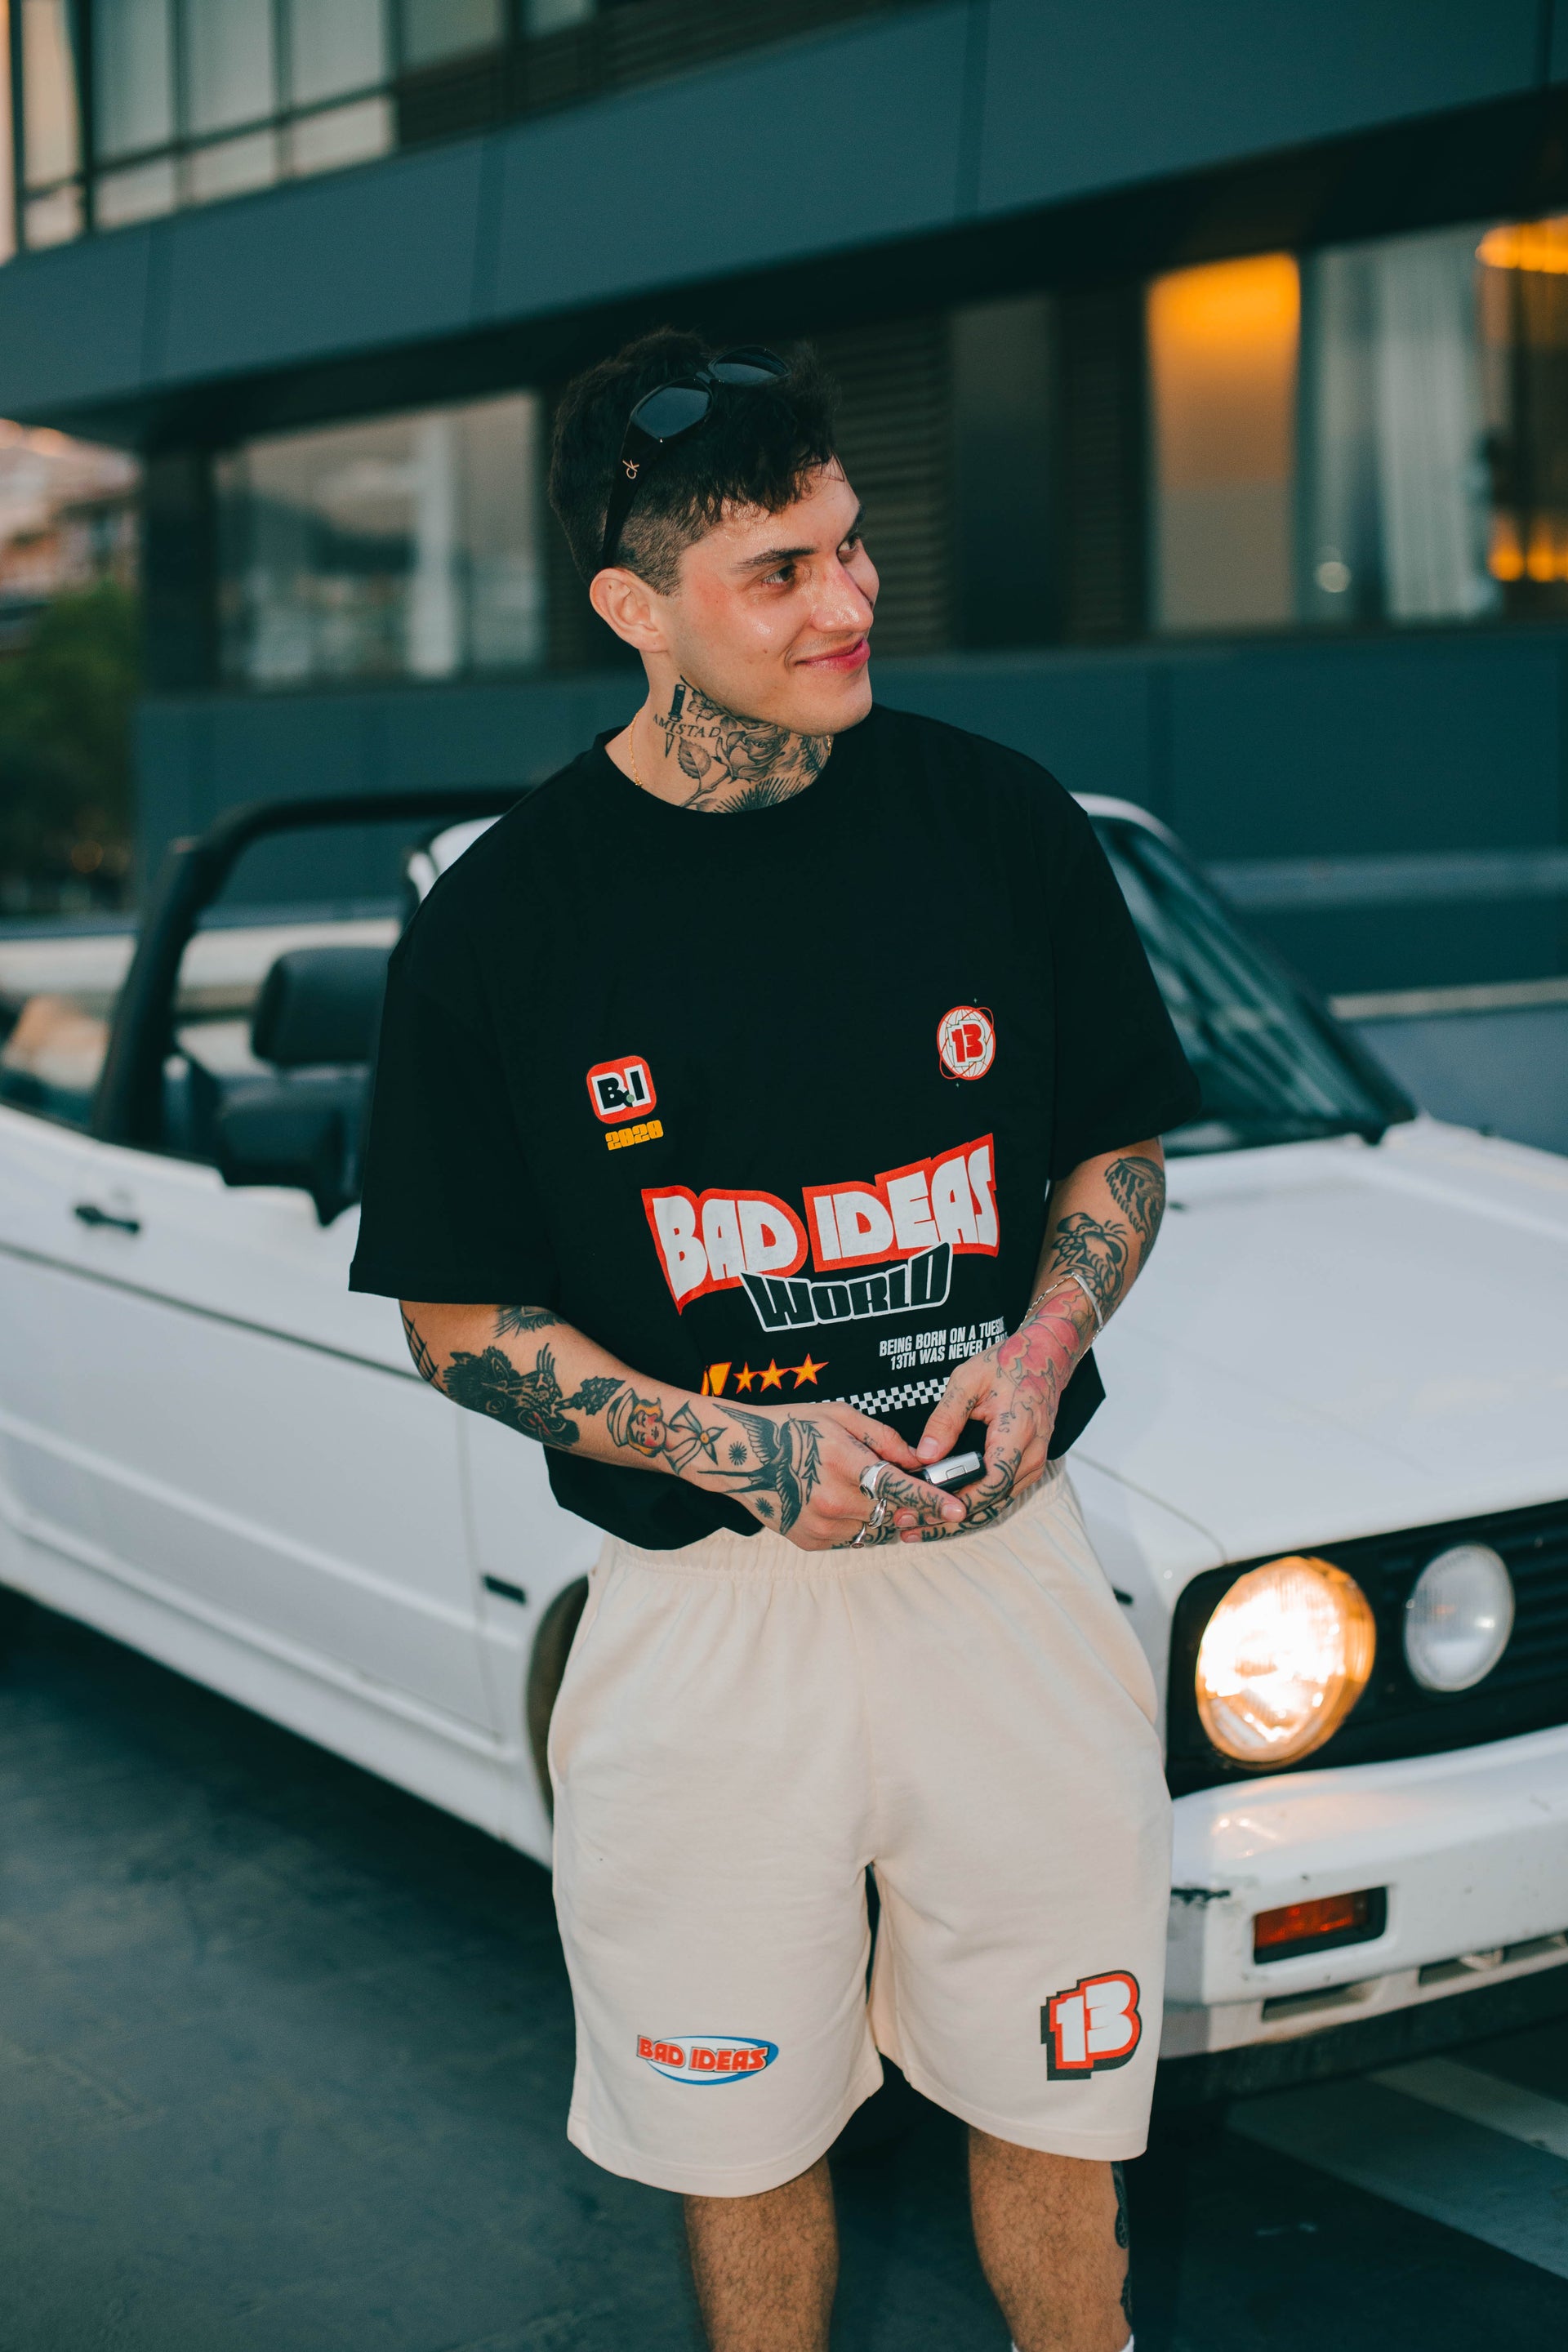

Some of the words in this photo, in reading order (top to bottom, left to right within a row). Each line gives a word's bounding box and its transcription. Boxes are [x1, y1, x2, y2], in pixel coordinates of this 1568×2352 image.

[653, 713, 721, 737] AMISTAD
[950, 1022, 985, 1065] 13
[605, 1120, 664, 1151] 2020
[647, 1190, 803, 1309] BAD
[808, 1139, 999, 1267] IDEAS
[740, 1242, 953, 1333] WORLD
[880, 1336, 912, 1356] BEING
[915, 1330, 947, 1350] BORN
[950, 1326, 965, 1343] ON
[969, 1325, 976, 1340] A
[890, 1351, 916, 1370] 13TH
[920, 1346, 946, 1365] WAS
[948, 1339, 983, 1361] NEVER
[1049, 1974, 1140, 2069] 13
[637, 2035, 685, 2068] BAD
[689, 2047, 768, 2072] IDEAS
